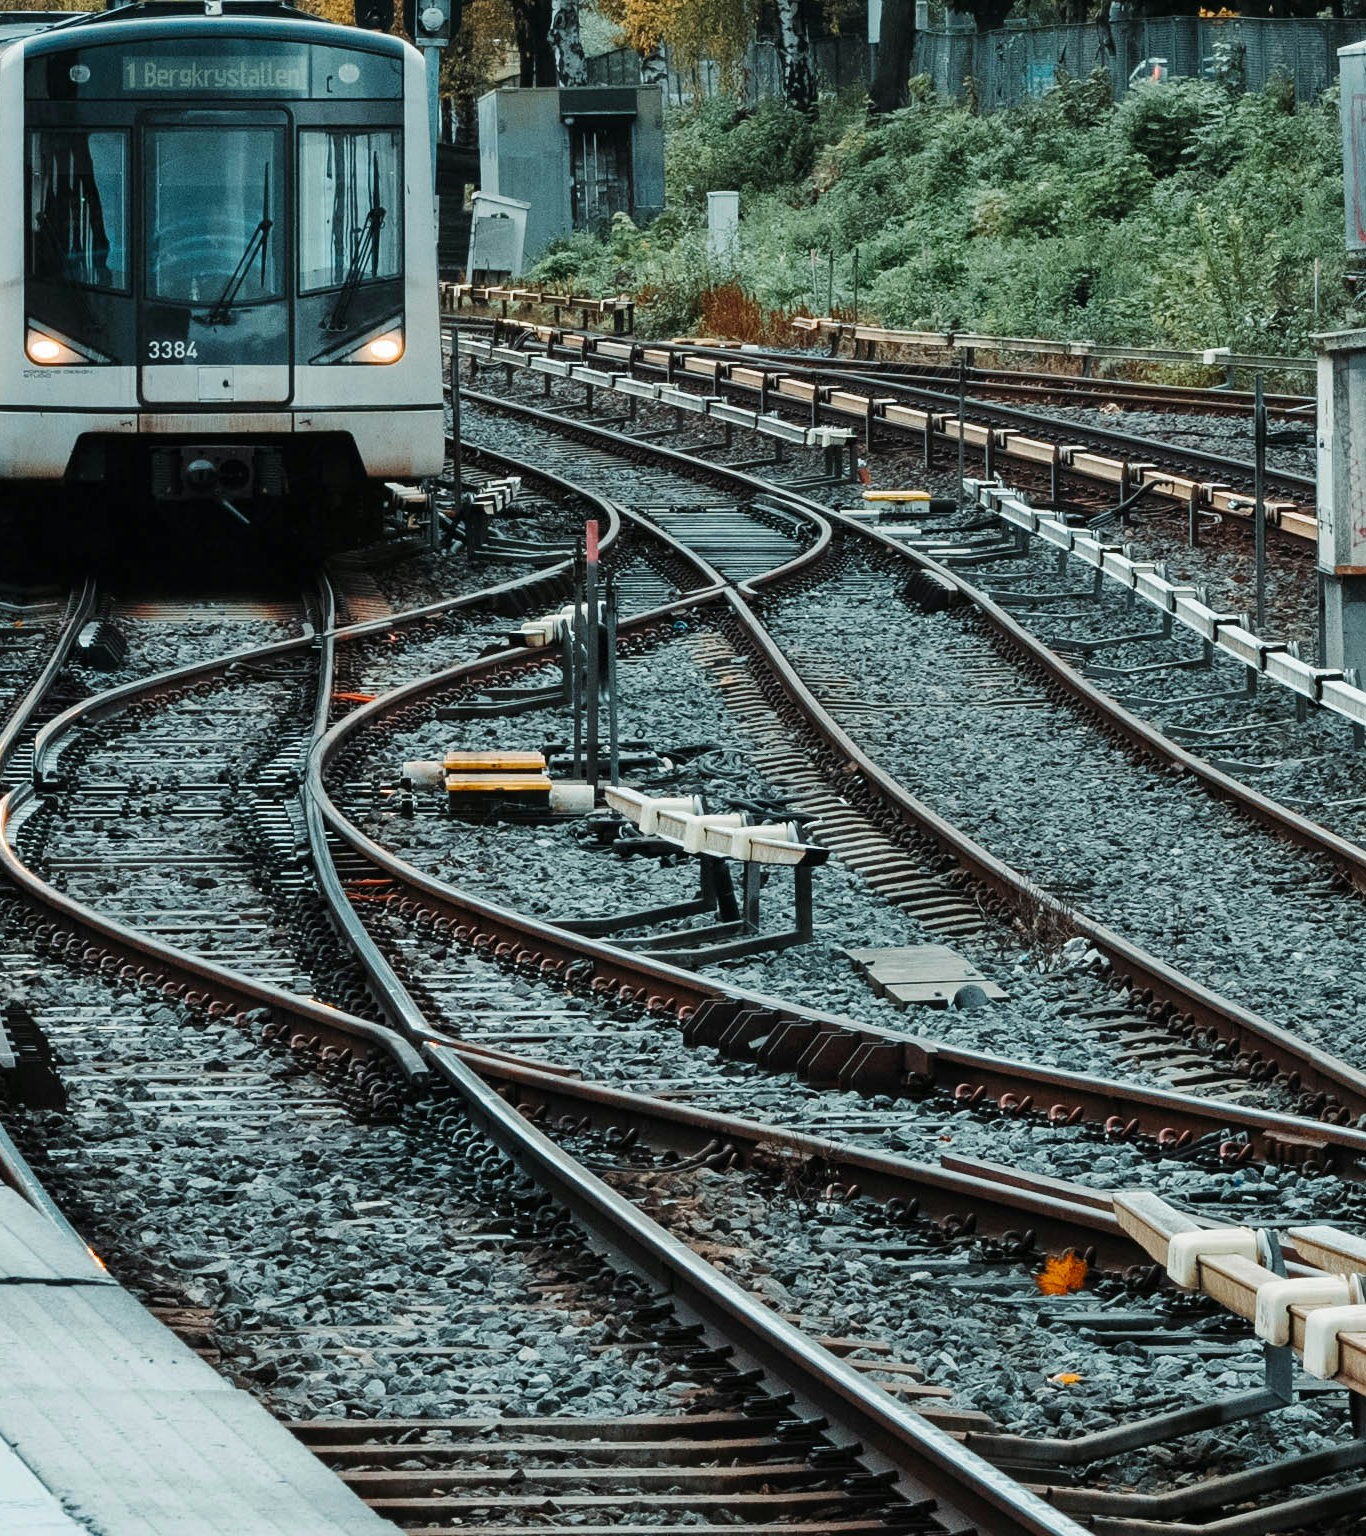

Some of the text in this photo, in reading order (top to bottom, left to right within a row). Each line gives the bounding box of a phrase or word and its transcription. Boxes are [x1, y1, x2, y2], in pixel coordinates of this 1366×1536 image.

[126, 61, 303, 89] 1 Bergkrystallen
[148, 340, 198, 359] 3384
